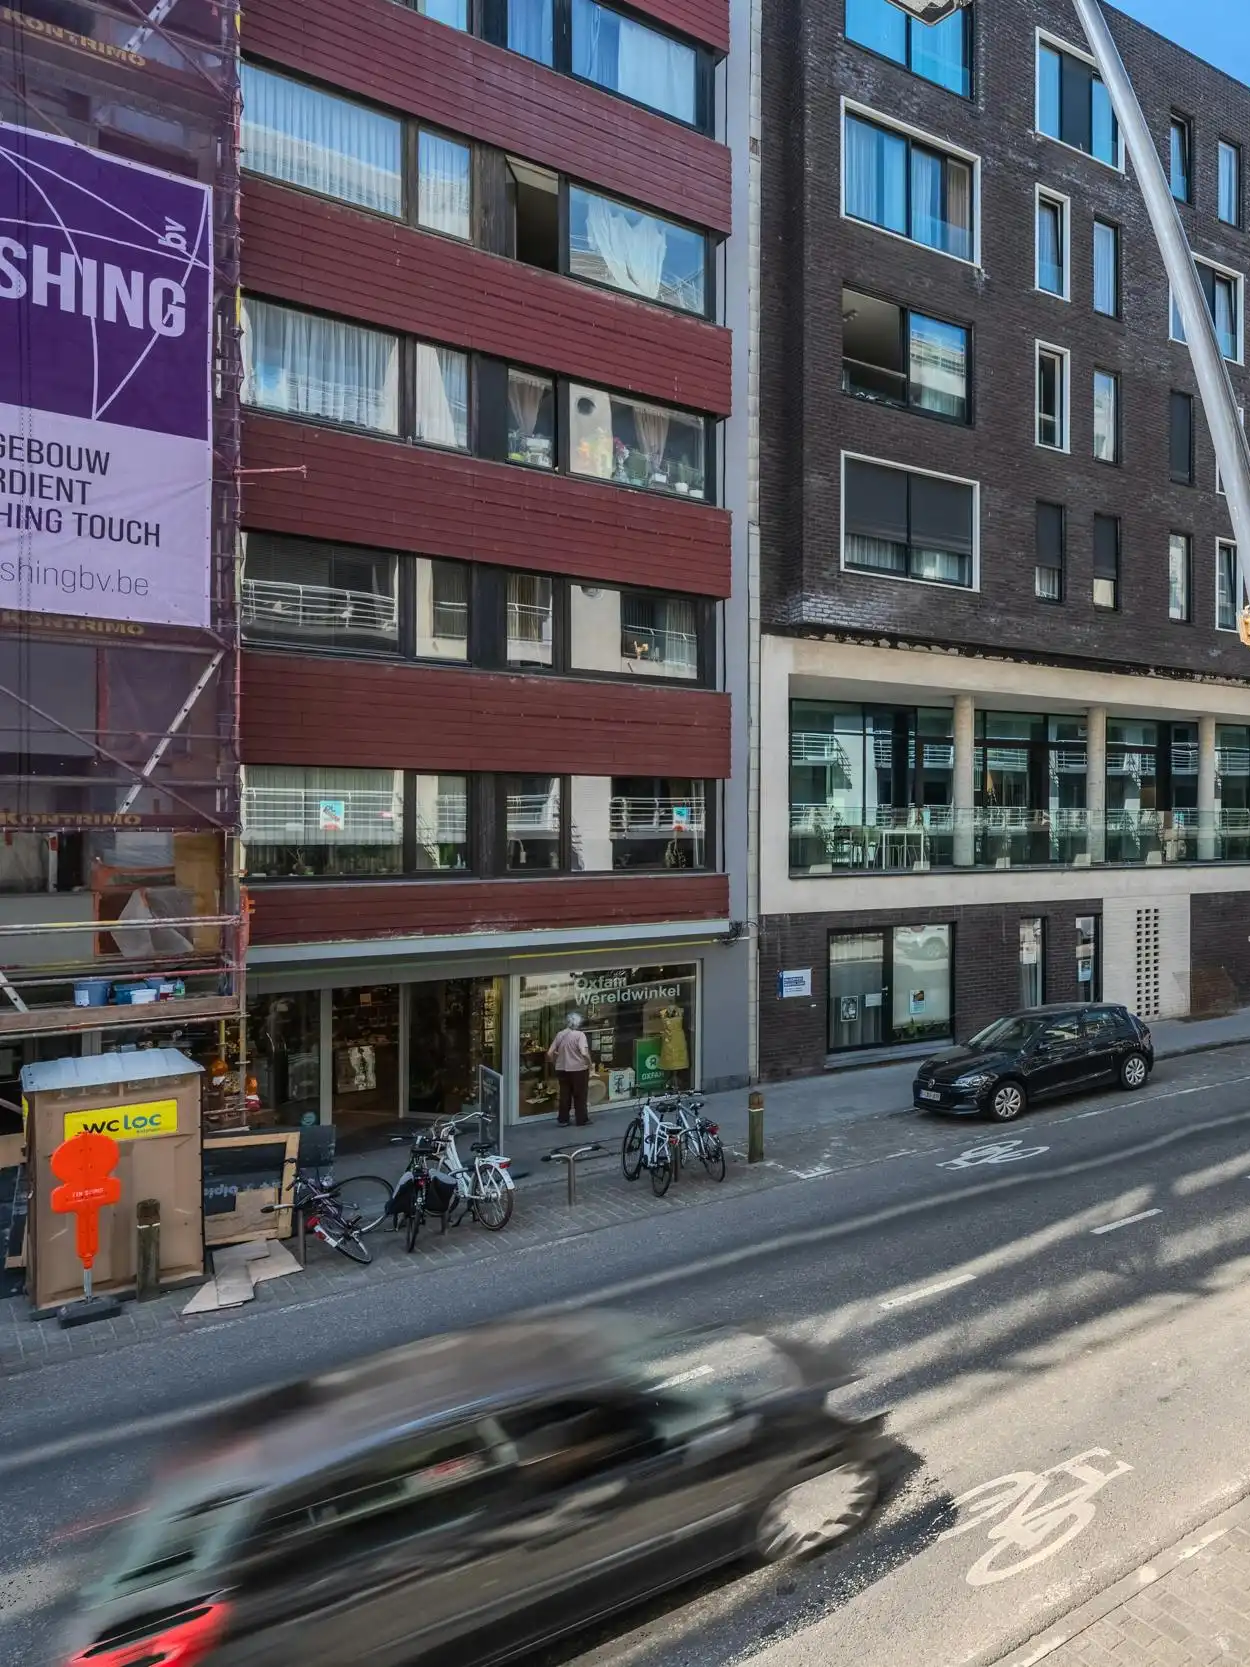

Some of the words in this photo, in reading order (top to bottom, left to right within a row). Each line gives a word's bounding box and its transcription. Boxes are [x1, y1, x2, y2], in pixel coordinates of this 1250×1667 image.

[158, 216, 187, 250] bv
[72, 512, 160, 548] TOUCH
[1, 557, 149, 596] shingbv.be
[575, 984, 680, 1005] Wereldwinkel
[576, 976, 627, 989] Oxfam
